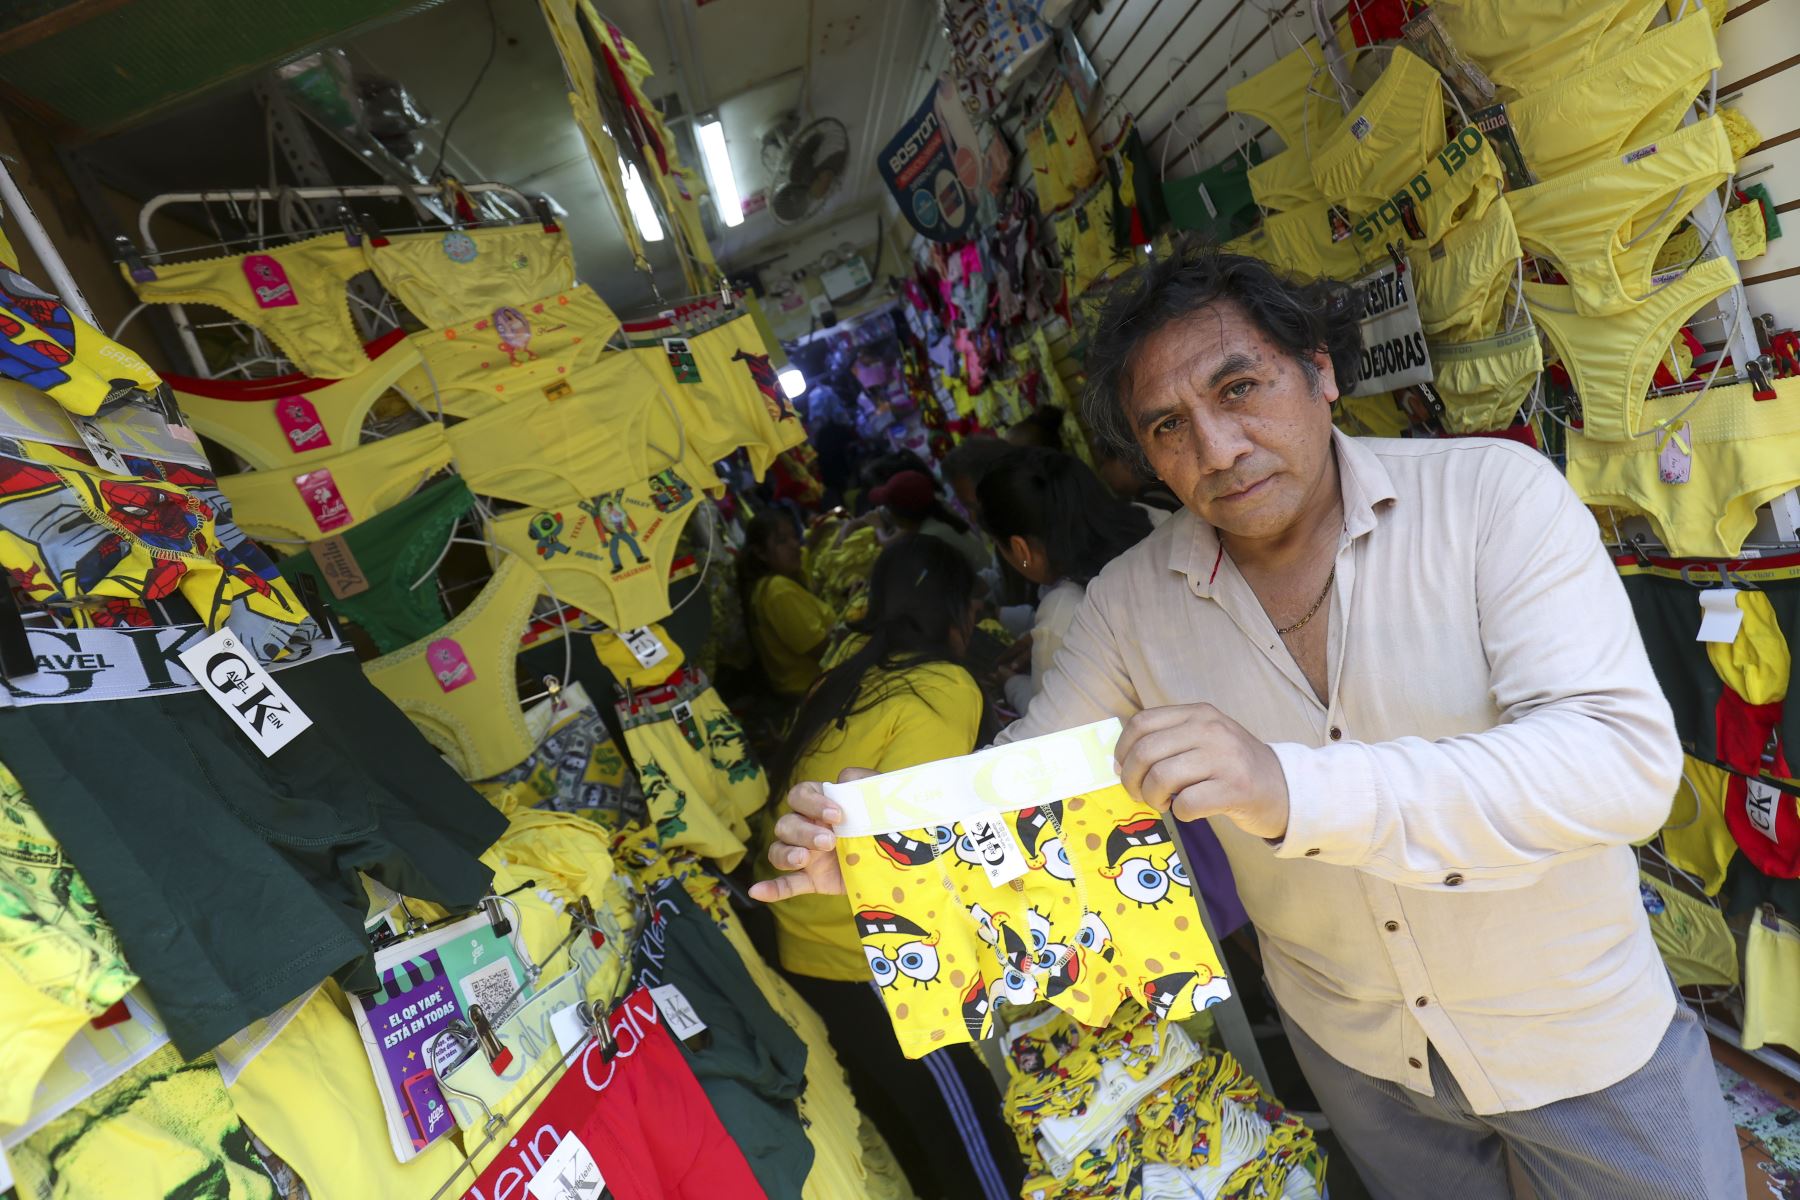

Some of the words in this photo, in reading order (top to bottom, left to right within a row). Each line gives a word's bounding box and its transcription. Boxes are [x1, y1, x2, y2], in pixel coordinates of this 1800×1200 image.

[1438, 126, 1483, 177] 130
[384, 1027, 413, 1050] ESTÁ
[410, 1017, 426, 1032] EN
[425, 1000, 456, 1025] TODAS
[388, 1013, 403, 1028] EL
[402, 1003, 418, 1021] QR
[417, 990, 443, 1012] YAPE
[428, 1104, 444, 1133] yape
